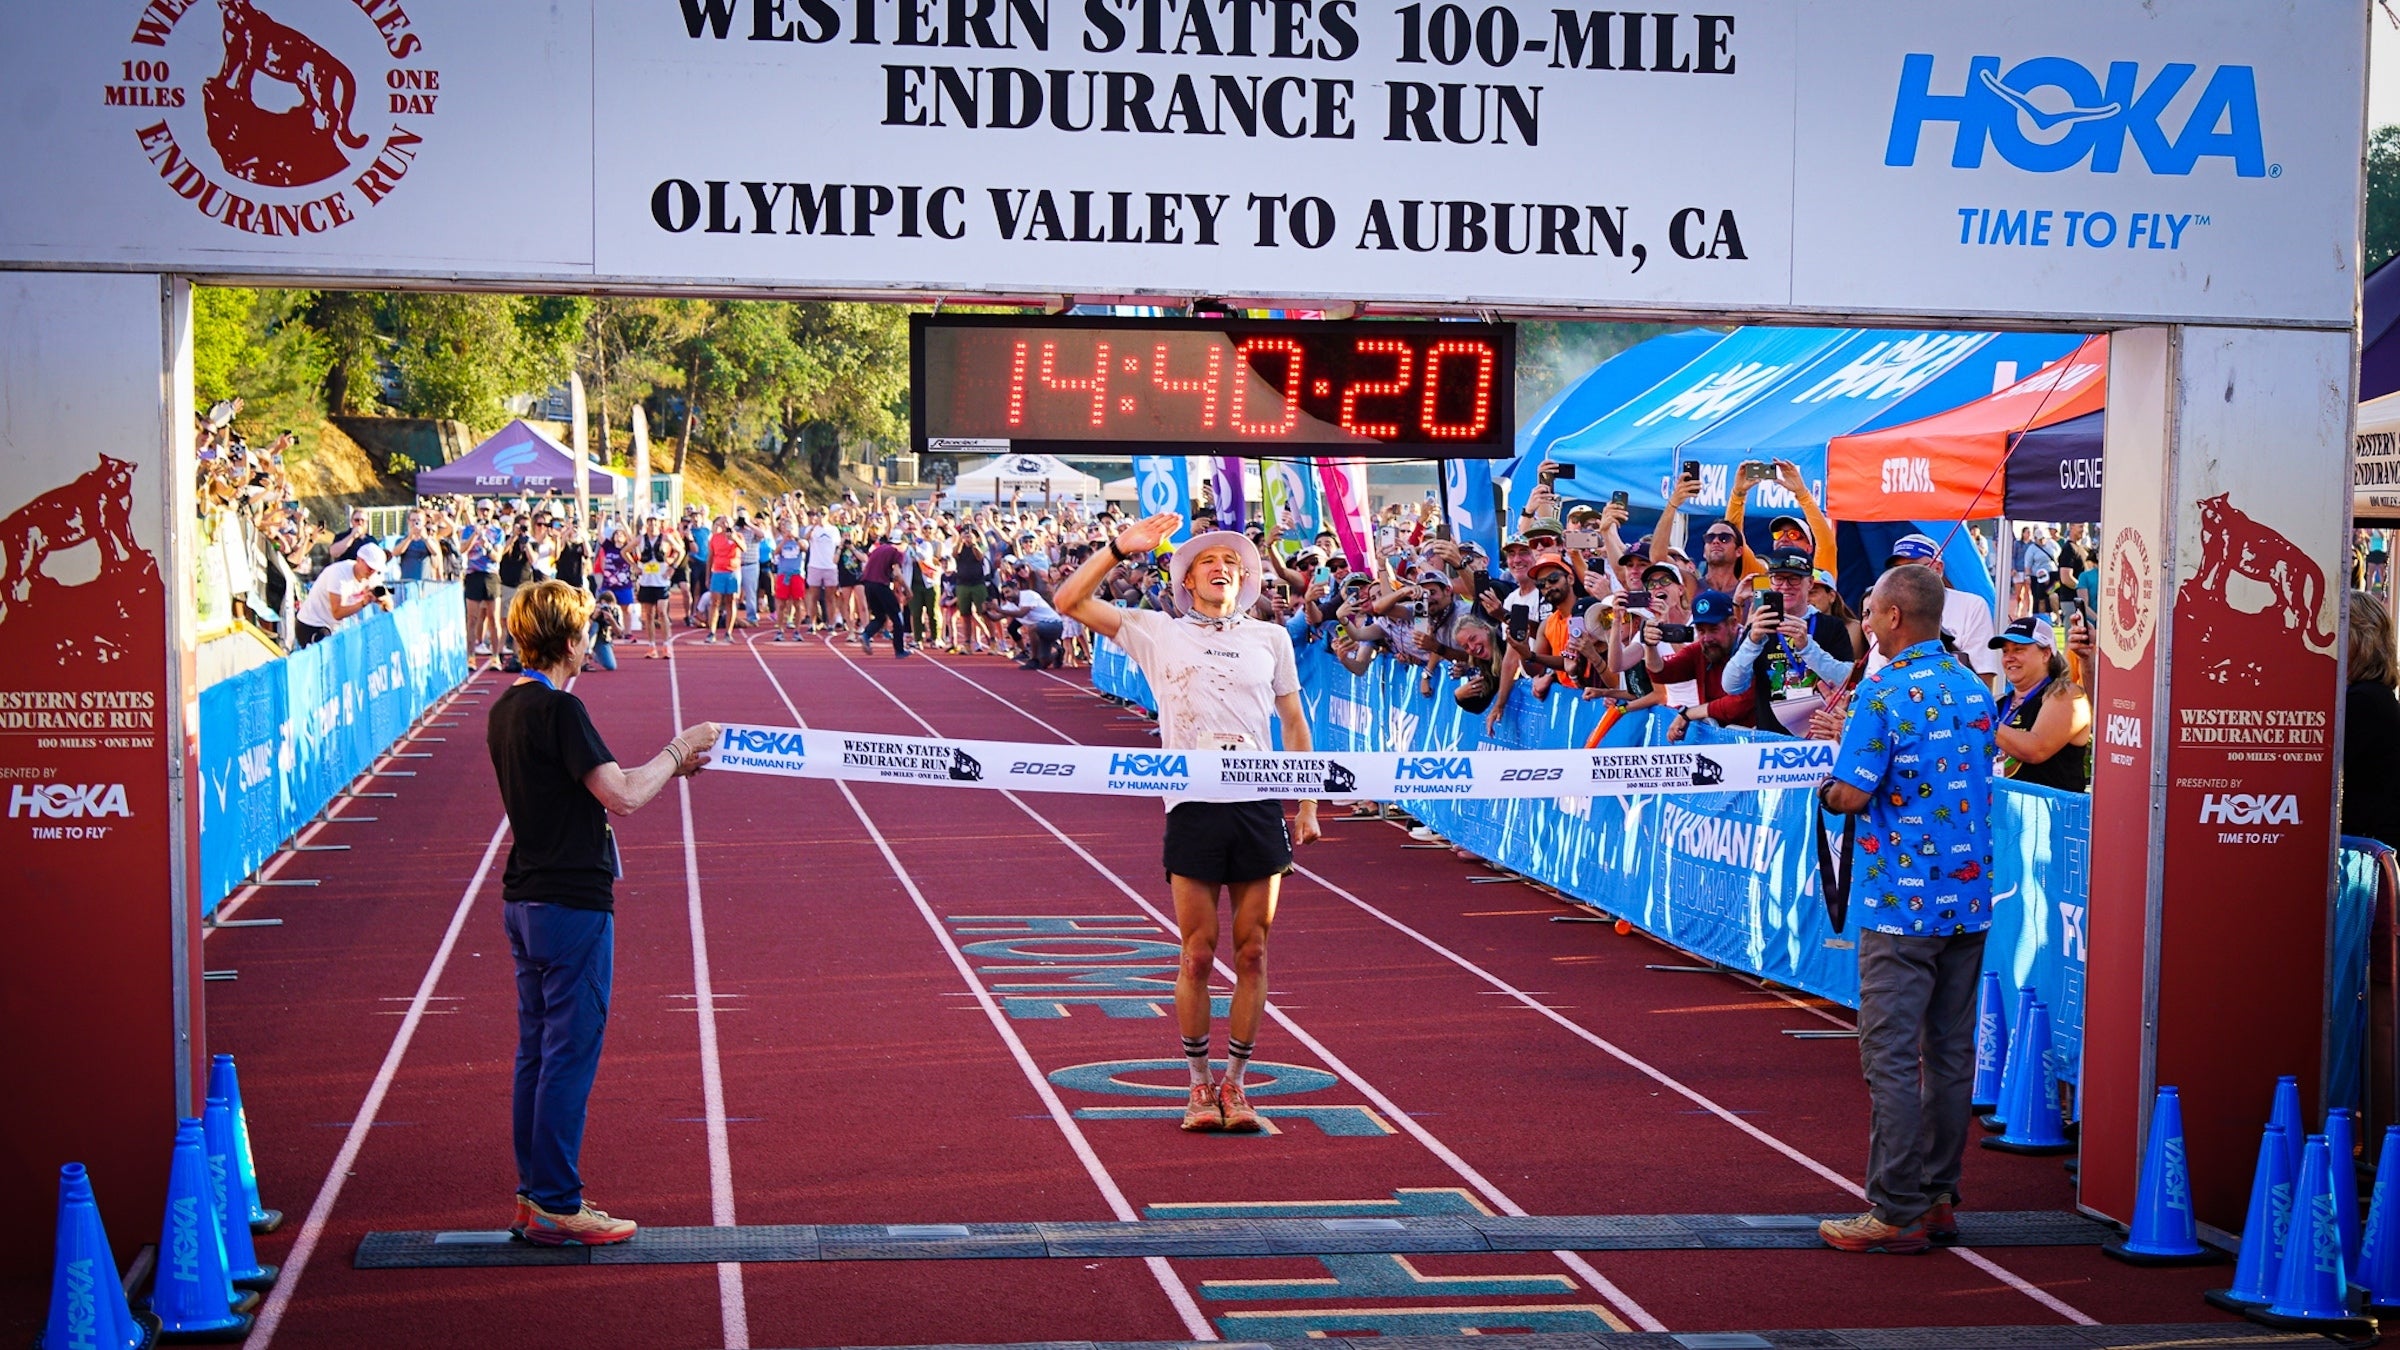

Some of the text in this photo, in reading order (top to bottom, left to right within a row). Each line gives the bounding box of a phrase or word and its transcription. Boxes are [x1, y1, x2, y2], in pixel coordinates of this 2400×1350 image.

[677, 0, 1736, 75] WESTERN STATES 100-MILE
[122, 60, 169, 82] 100
[387, 69, 439, 90] ONE
[104, 86, 185, 108] MILES
[389, 94, 438, 114] DAY
[881, 64, 1544, 146] ENDURANCE RUN
[136, 118, 423, 237] ENDURANCE RUN
[650, 178, 1748, 274] OLYMPIC VALLEY TO AUBURN, CA
[1957, 207, 2053, 246] TIME
[2063, 210, 2117, 249] TO
[476, 475, 552, 486] FLEET FEET
[1909, 669, 1934, 680] HOKA
[0, 692, 155, 709] ESTERN STATES
[0, 711, 154, 729] NDURANCE RUN
[2180, 709, 2326, 727] WESTERN STATES
[1929, 730, 1952, 740] HOKA
[2106, 714, 2142, 749] HOKA
[2180, 728, 2324, 744] ENDURANCE RUN
[38, 739, 155, 748] 100 MILES ONE DAY
[724, 728, 805, 757] HOKA
[844, 740, 950, 757] WESTERN STATES
[722, 755, 804, 770] FLY HUMAN FLY
[843, 753, 947, 770] ENDURANCE RUN
[1109, 753, 1189, 777] HOKA
[1221, 758, 1325, 771] WESTERN STATES
[1592, 753, 1692, 767] WESTERN STATES
[1758, 745, 1834, 769] HOKA
[1894, 754, 1919, 763] HOKA
[2227, 752, 2323, 762] 100 MILES ONE DAY
[43, 768, 57, 778] BY
[1010, 761, 1075, 776] 2023
[1395, 757, 1473, 780] HOKA
[1500, 769, 1563, 781] 2023
[1592, 766, 1690, 779] ENDURANCE RUN
[1854, 766, 1878, 782] HOKA
[1108, 780, 1189, 791] FLY HUMAN FLY
[1221, 771, 1322, 784] ENDURANCE RUN
[1757, 774, 1773, 784] FLY
[1775, 772, 1815, 783] HUMAN
[1948, 780, 1967, 790] HOKA
[2176, 778, 2242, 788] PRESENTED BY
[1395, 785, 1472, 793] FLY HUMAN FLY
[8, 784, 130, 818] HOKA
[2199, 794, 2300, 825] HOKA
[1899, 816, 1923, 824] HOKA
[32, 827, 63, 839] TIME
[65, 827, 84, 839] TO
[1661, 802, 1684, 848] FLY
[1678, 810, 1752, 868] HUMAN
[1751, 825, 1782, 873] FLY
[2218, 833, 2243, 843] TIME
[2245, 833, 2260, 843] TO
[1951, 843, 1971, 854] HOKA
[1898, 878, 1924, 887] HOKA
[1936, 894, 1958, 904] HOKA
[1877, 924, 1904, 935] HOKA
[2059, 902, 2086, 962] FL
[945, 914, 1232, 1018] HOME
[1979, 1013, 1998, 1071] HOKA
[1047, 1058, 1400, 1137] OF
[2165, 1136, 2186, 1210] HOKA
[173, 1196, 198, 1282] HOKA
[2312, 1193, 2338, 1274] HOKA
[68, 1258, 96, 1350] HOKA
